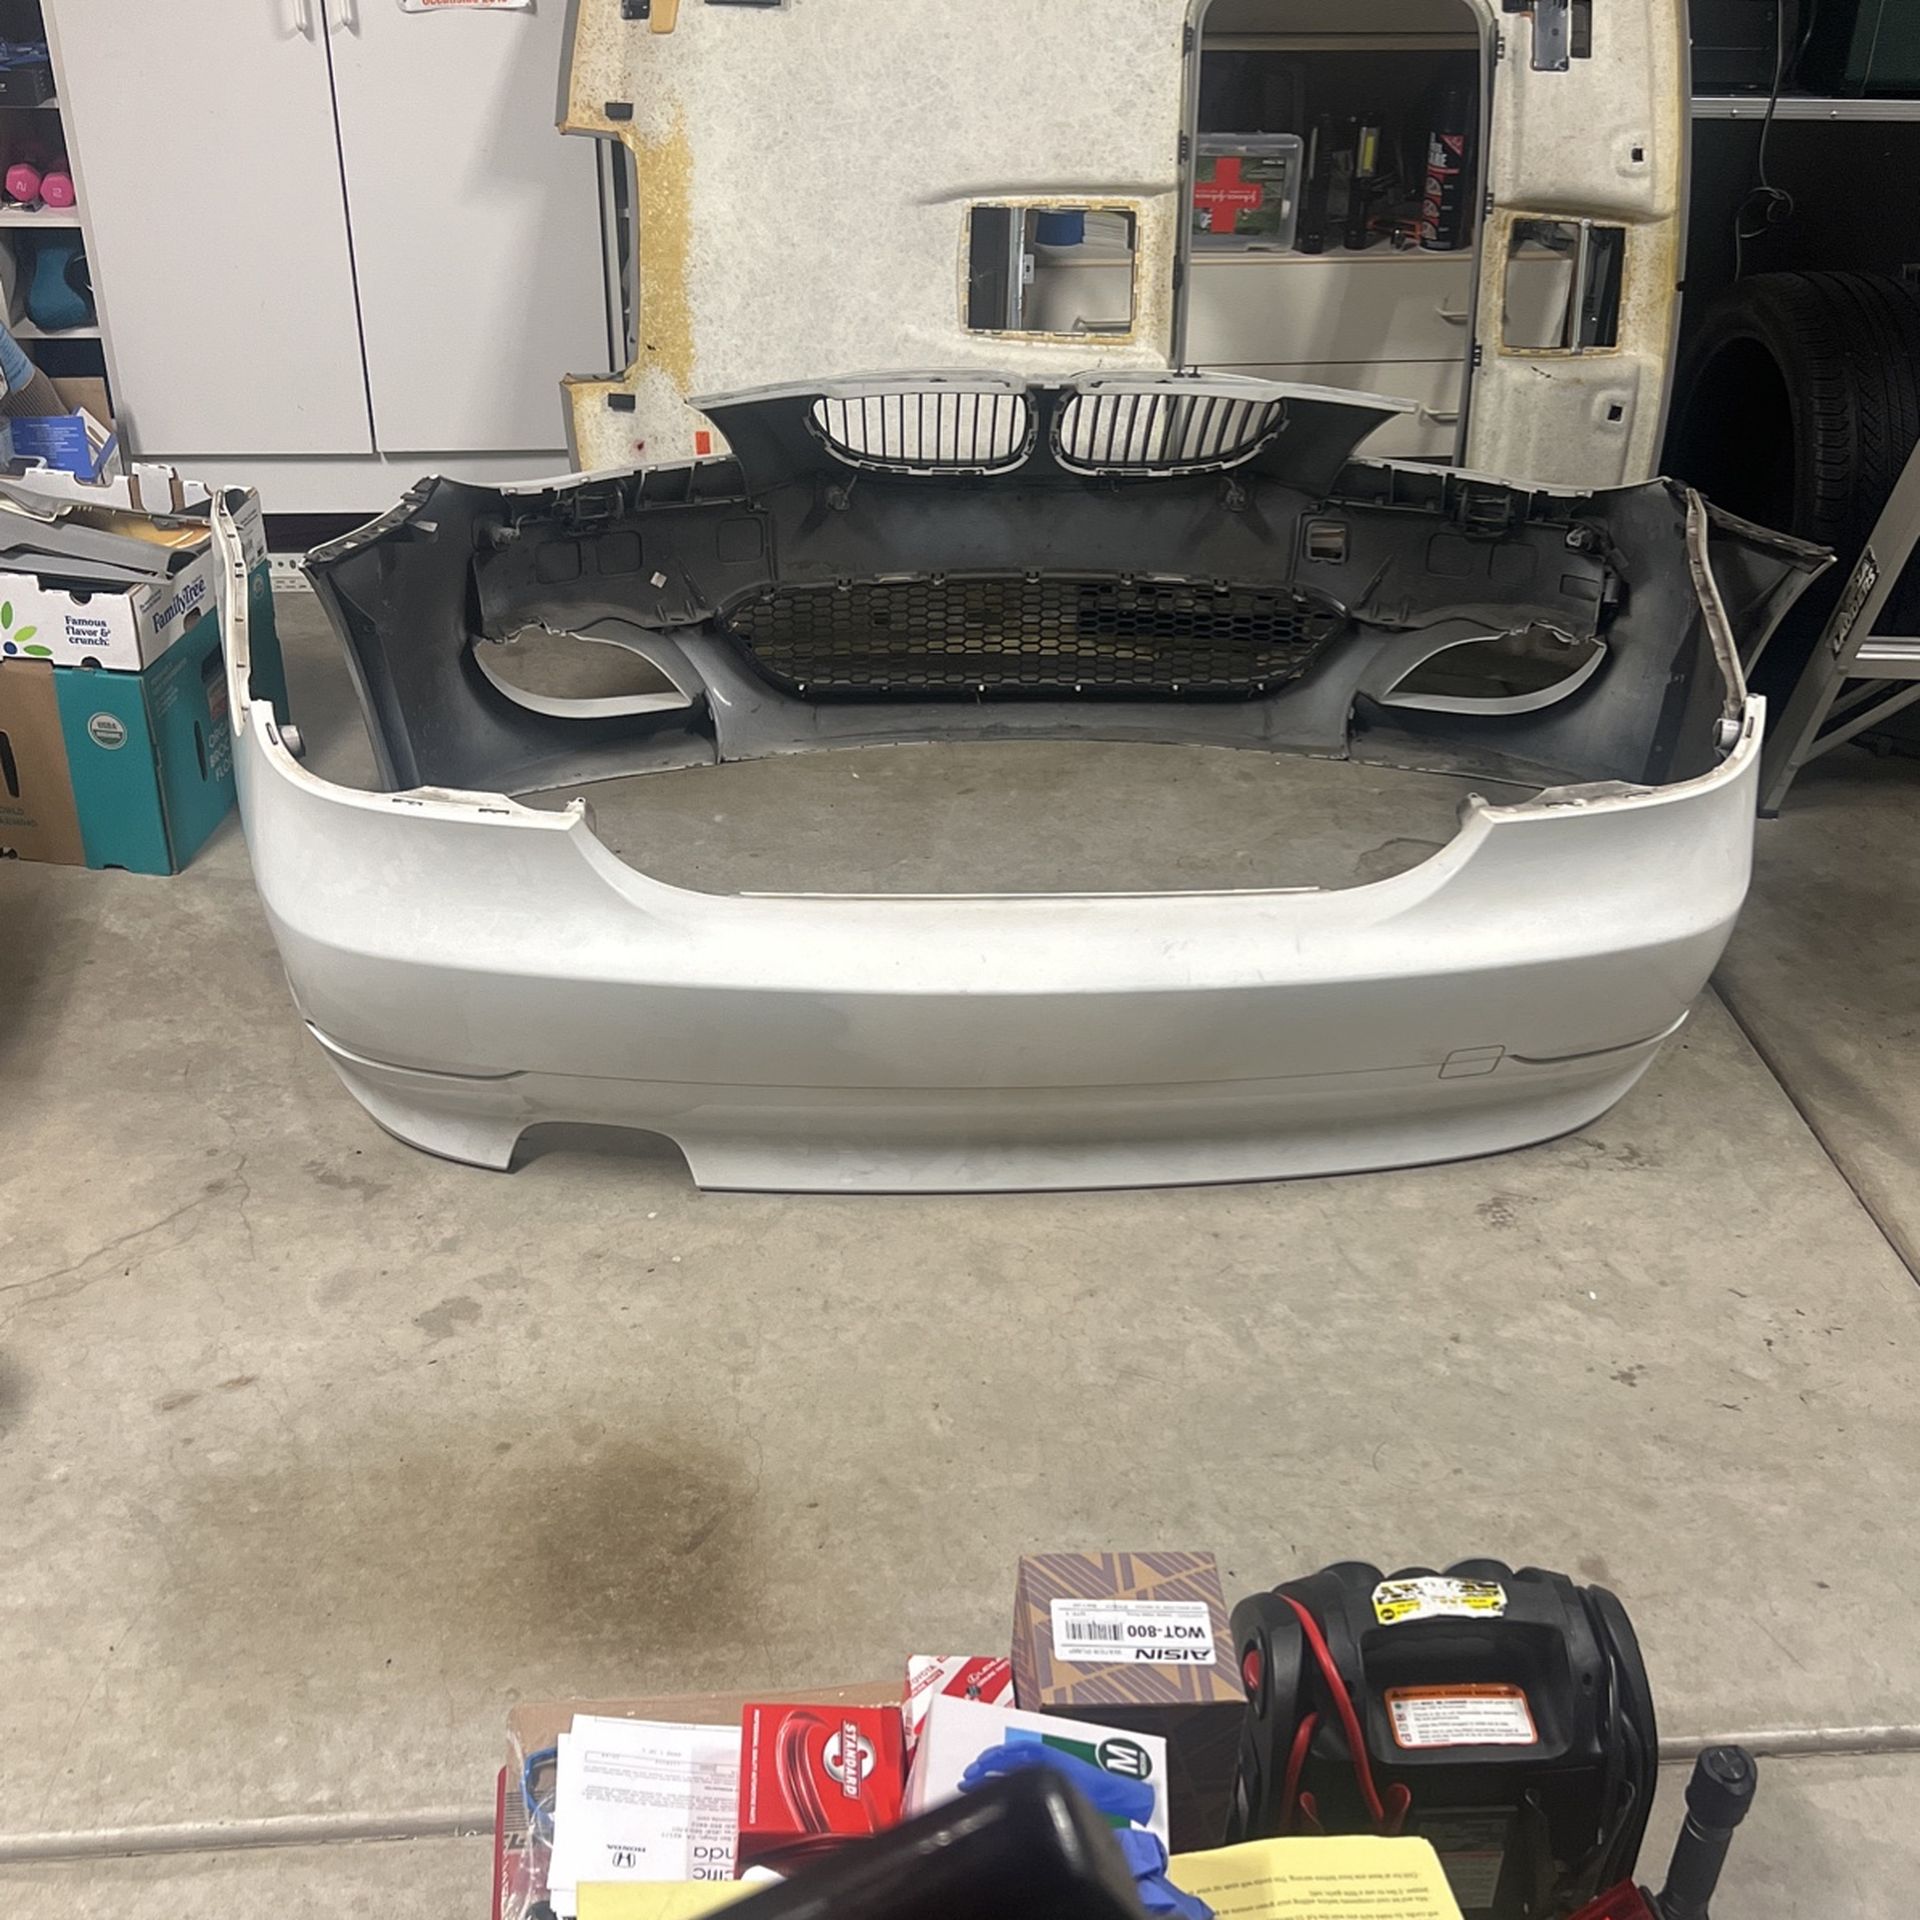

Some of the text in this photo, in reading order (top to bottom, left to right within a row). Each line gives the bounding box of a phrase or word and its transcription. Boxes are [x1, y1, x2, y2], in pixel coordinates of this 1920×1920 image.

[152, 579, 207, 634] FamilyTree
[64, 615, 107, 627] Famous
[65, 625, 98, 637] flavor
[1127, 1625, 1205, 1639] WQT-800
[1135, 1649, 1211, 1661] AISIN
[844, 1723, 858, 1796] STANDARD
[1106, 1743, 1138, 1775] M
